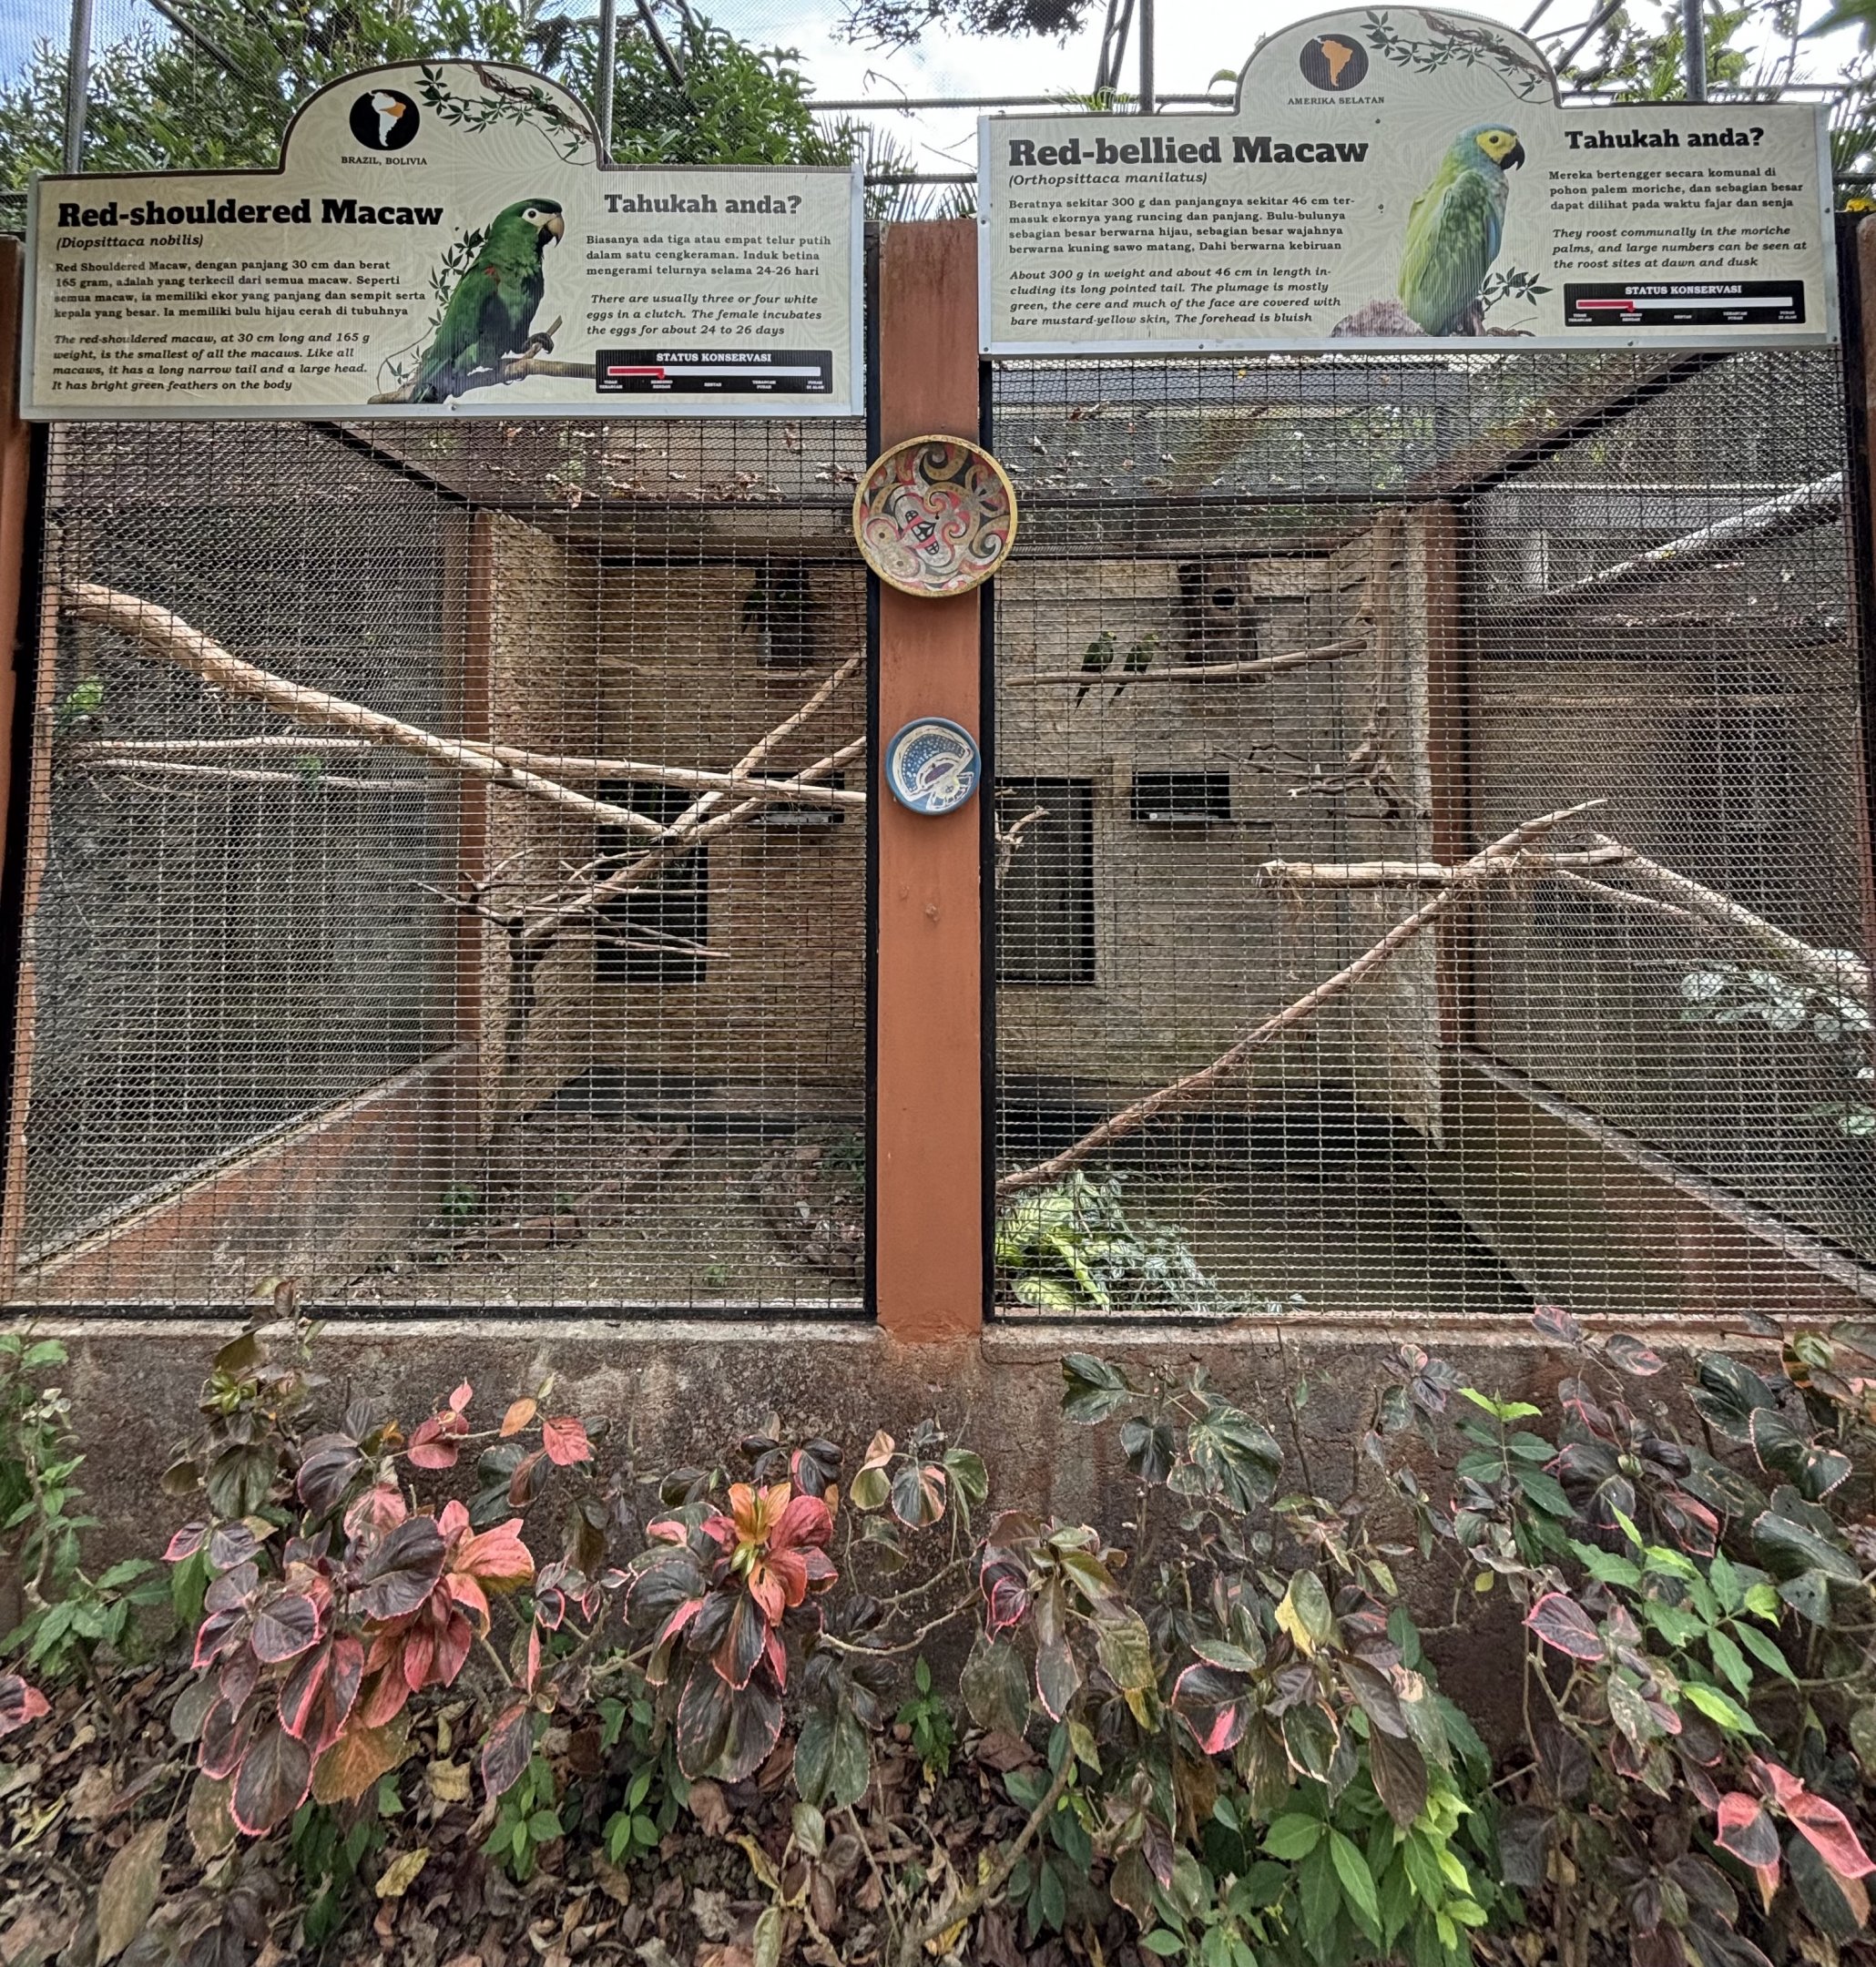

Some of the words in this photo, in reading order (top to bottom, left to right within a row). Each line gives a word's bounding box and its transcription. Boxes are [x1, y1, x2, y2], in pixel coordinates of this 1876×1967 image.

[1287, 97, 1336, 105] AMERIKA
[1338, 96, 1384, 105] SELATAN
[1564, 128, 1680, 149] Tahukah
[1687, 127, 1764, 148] anda?
[1008, 136, 1222, 167] Red-bellied
[1232, 136, 1369, 163] Macaw
[341, 156, 382, 166] BRAZIL,
[385, 157, 427, 165] BOLIVIA
[1008, 173, 1120, 189] (Orthopsittaca
[1125, 171, 1207, 185] manilatus)
[1548, 169, 1593, 179] Mereka
[1596, 169, 1662, 180] bertengger
[1708, 167, 1761, 178] komunal
[1764, 167, 1776, 177] di
[604, 193, 718, 213] Tahukah
[725, 194, 801, 214] anda?
[1008, 199, 1063, 210] Beratnya
[1065, 198, 1108, 208] sekitar
[1111, 197, 1135, 207] 300
[1138, 199, 1146, 209] g
[1148, 197, 1171, 206] dan
[1175, 196, 1243, 209] panjangnya
[1247, 196, 1289, 206] sekitar
[1291, 196, 1307, 205] 46
[1332, 196, 1354, 205] ter-
[1550, 200, 1585, 212] dapat
[1587, 199, 1628, 209] dilihat
[1631, 199, 1660, 211] pada
[1663, 199, 1700, 209] waktu
[1704, 198, 1732, 210] fajar
[1736, 198, 1759, 208] dan
[1761, 197, 1793, 209] senja
[57, 198, 311, 228] Red-shouldered
[321, 198, 444, 225] Macaw
[1009, 214, 1048, 224] masuk
[1052, 213, 1100, 224] ekornya
[1104, 214, 1133, 224] yang
[1137, 211, 1183, 223] runcing
[1186, 211, 1208, 220] dan
[1212, 211, 1262, 223] panjang.
[1266, 210, 1346, 222] Bulu-bulunya
[1552, 228, 1582, 240] They
[1585, 228, 1617, 238] roost
[1620, 227, 1697, 239] communally
[1699, 227, 1713, 236] in
[1717, 226, 1737, 236] the
[1740, 225, 1790, 235] moriche
[56, 236, 145, 251] (Diopsittaca
[149, 233, 203, 248] nobilis)
[586, 235, 639, 246] Biasanya
[643, 234, 664, 243] ada
[667, 234, 690, 246] tiga
[694, 235, 720, 243] atau
[724, 235, 762, 247] empat
[766, 235, 795, 244] telur
[799, 235, 831, 248] putih
[1551, 243, 1594, 256] palms,
[1597, 242, 1622, 252] and
[1626, 242, 1657, 254] large
[1661, 241, 1714, 251] numbers
[1718, 243, 1740, 251] can
[1744, 241, 1759, 250] be
[1793, 240, 1807, 250] at
[586, 250, 622, 260] dalam
[626, 250, 651, 260] satu
[655, 250, 739, 261] cengkeraman.
[743, 250, 779, 260] Induk
[781, 250, 820, 260] betina
[1553, 259, 1574, 269] the
[1577, 259, 1608, 269] roost
[1611, 259, 1641, 268] sites
[1644, 259, 1657, 268] at
[1661, 258, 1695, 267] dawn
[1698, 257, 1724, 267] and
[1727, 256, 1758, 266] dusk
[1009, 270, 1045, 280] About
[1048, 270, 1073, 279] 300
[1076, 271, 1084, 280] g
[1087, 269, 1100, 279] in
[1104, 268, 1145, 280] weight
[1148, 268, 1173, 277] and
[1176, 268, 1211, 277] about
[1214, 267, 1230, 277] 46
[1256, 267, 1268, 276] in
[1272, 267, 1311, 279] length
[1315, 266, 1331, 276] in-
[1625, 286, 1667, 295] STATUS
[1669, 284, 1742, 294] KONSERVASI
[590, 293, 625, 303] There
[652, 293, 698, 305] usually
[701, 293, 734, 303] three
[738, 295, 751, 303] or
[752, 293, 780, 306] four
[784, 294, 818, 304] white
[54, 308, 91, 320] kepala
[94, 310, 122, 320] yang
[125, 307, 159, 317] besar.
[163, 307, 175, 316] Ia
[178, 306, 231, 316] memiliki
[234, 306, 260, 316] bulu
[264, 306, 295, 318] hijau
[298, 305, 331, 315] cerah
[335, 305, 347, 315] di
[351, 305, 408, 318] tubuhnya
[586, 311, 614, 321] eggs
[617, 309, 629, 319] in
[644, 309, 686, 319] clutch.
[691, 309, 714, 319] The
[715, 309, 759, 321] female
[762, 309, 821, 320] incubates
[1010, 316, 1037, 325] bare
[1042, 314, 1137, 326] mustard-yellow
[1139, 313, 1170, 325] skin,
[1174, 313, 1198, 323] The
[1198, 312, 1256, 325] forehead
[1259, 312, 1269, 322] is
[1273, 312, 1312, 322] bluish
[586, 325, 607, 335] the
[609, 327, 637, 337] eggs
[637, 324, 658, 337] for
[661, 324, 697, 334] about
[699, 324, 716, 334] 24
[719, 325, 732, 334] to
[735, 324, 752, 334] 26
[755, 325, 784, 337] days
[53, 350, 97, 362] weight,
[100, 350, 111, 359] is
[115, 350, 134, 359] the
[137, 349, 189, 359] smallest
[191, 349, 205, 361] of
[206, 348, 224, 358] all
[227, 349, 247, 358] the
[306, 347, 333, 358] Like
[336, 347, 354, 357] all
[656, 352, 698, 362] STATUS
[700, 352, 771, 362] KONSERVASI
[51, 381, 62, 391] It
[65, 381, 87, 390] has
[90, 380, 128, 392] bright
[130, 382, 165, 392] green
[166, 380, 219, 392] feathers
[240, 380, 260, 390] the
[263, 379, 292, 392] body
